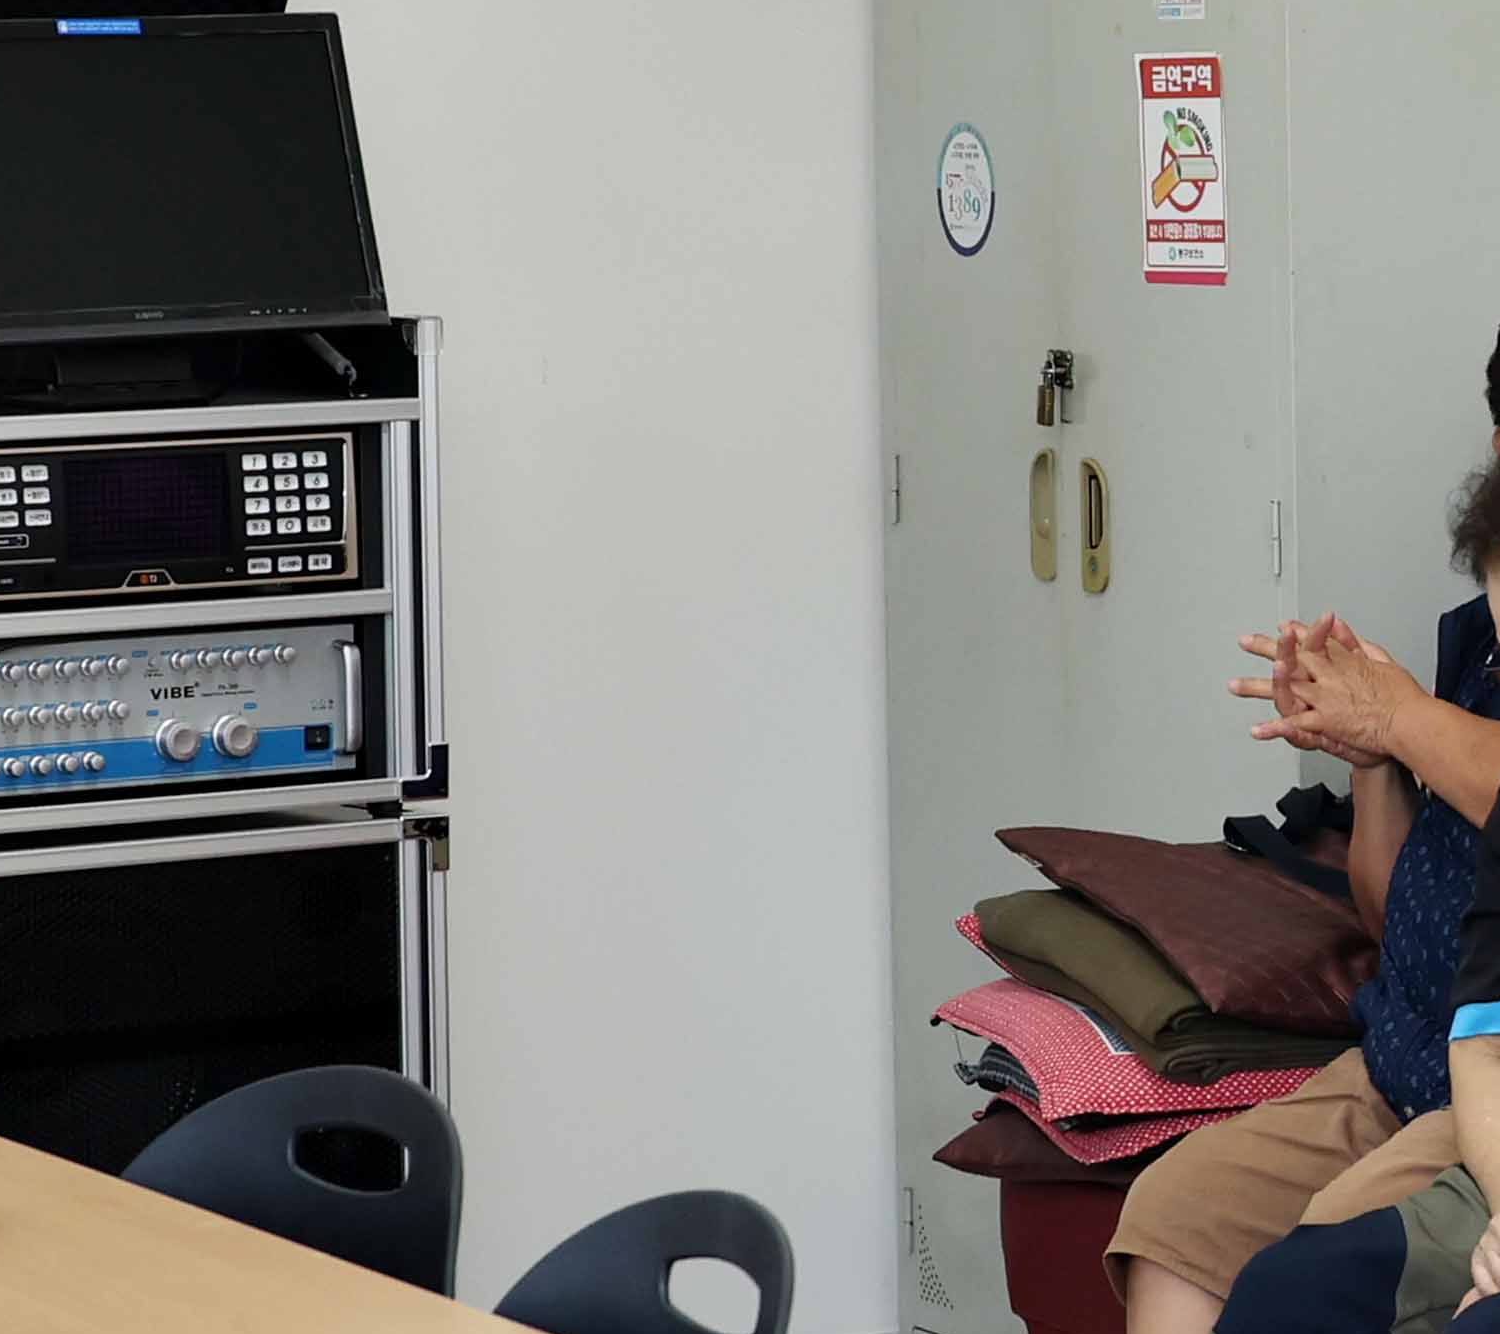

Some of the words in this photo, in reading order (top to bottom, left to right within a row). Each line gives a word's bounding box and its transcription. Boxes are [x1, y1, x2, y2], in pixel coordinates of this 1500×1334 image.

[1151, 65, 1214, 93] 금연구역
[1186, 110, 1214, 152] SMOKING
[948, 187, 981, 221] 1389
[150, 685, 196, 701] VIBE
